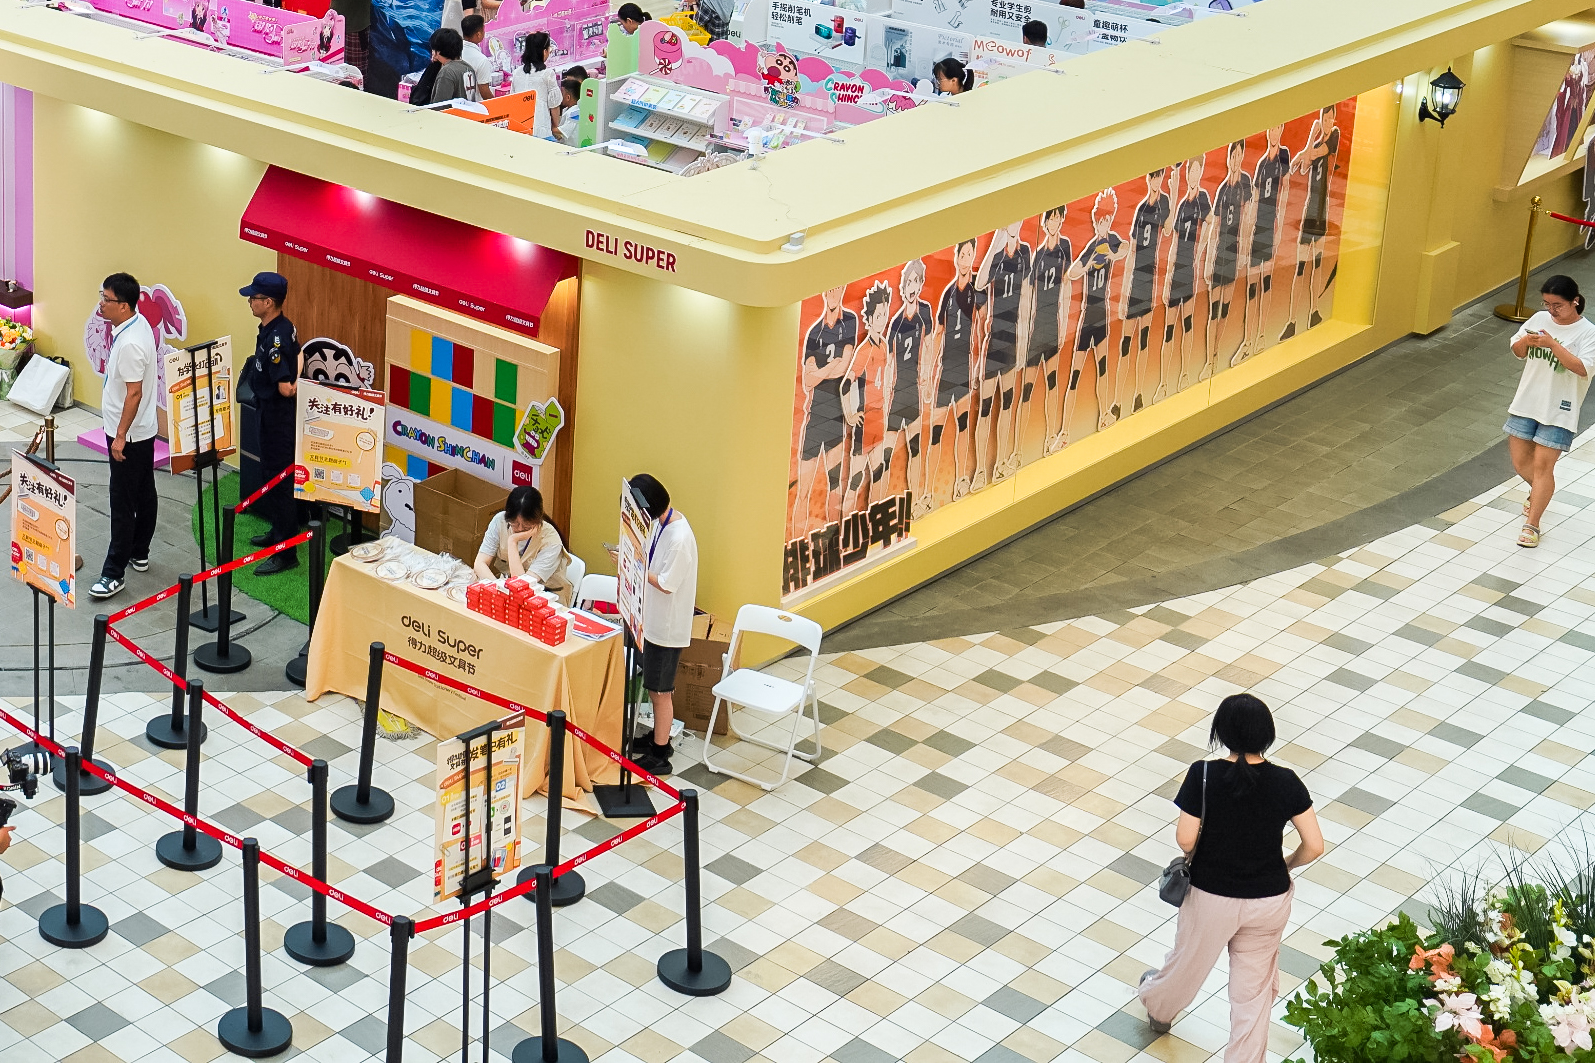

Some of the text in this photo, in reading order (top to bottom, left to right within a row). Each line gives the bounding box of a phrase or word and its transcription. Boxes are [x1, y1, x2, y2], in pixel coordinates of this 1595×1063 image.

[771, 1, 812, 18] 手摇削笔机
[990, 7, 1032, 24] 耐用又安全
[771, 11, 803, 26] 轻松削笔
[825, 78, 865, 95] CRAYON
[1264, 178, 1272, 198] 8
[1143, 223, 1151, 246] 9
[1184, 220, 1192, 243] 7
[584, 228, 677, 273] DELI SUPER
[1003, 272, 1015, 298] 11
[1044, 270, 1056, 291] 12
[1093, 269, 1104, 291] 10
[955, 309, 962, 331] 1
[903, 337, 913, 361] 2
[874, 367, 882, 390] 4
[307, 397, 375, 422] 关注有好礼!
[392, 420, 436, 449] CRAYON
[437, 436, 496, 471] SHINCHAN
[513, 469, 532, 482] deli
[18, 472, 69, 509] 关注有好礼!
[782, 490, 913, 597] 排球少年!!
[401, 615, 484, 660] deli Super
[385, 653, 399, 664] deli
[407, 636, 477, 676] 得力超级文具节
[425, 669, 439, 681] deli
[467, 686, 481, 697] deli
[509, 702, 525, 712] deli
[573, 728, 586, 740] deli
[609, 751, 623, 763] deli
[104, 772, 118, 784] deli
[646, 774, 659, 786] deli
[496, 781, 506, 792] 02
[143, 792, 157, 804] deli
[441, 794, 450, 803] 01
[183, 813, 197, 826] deli
[224, 834, 238, 846] deli
[610, 834, 623, 847] deli
[574, 853, 587, 865] deli
[283, 866, 299, 878] deli
[328, 888, 344, 901] deli
[488, 894, 503, 906] deli
[375, 911, 391, 924] deli
[442, 912, 459, 923] deli
